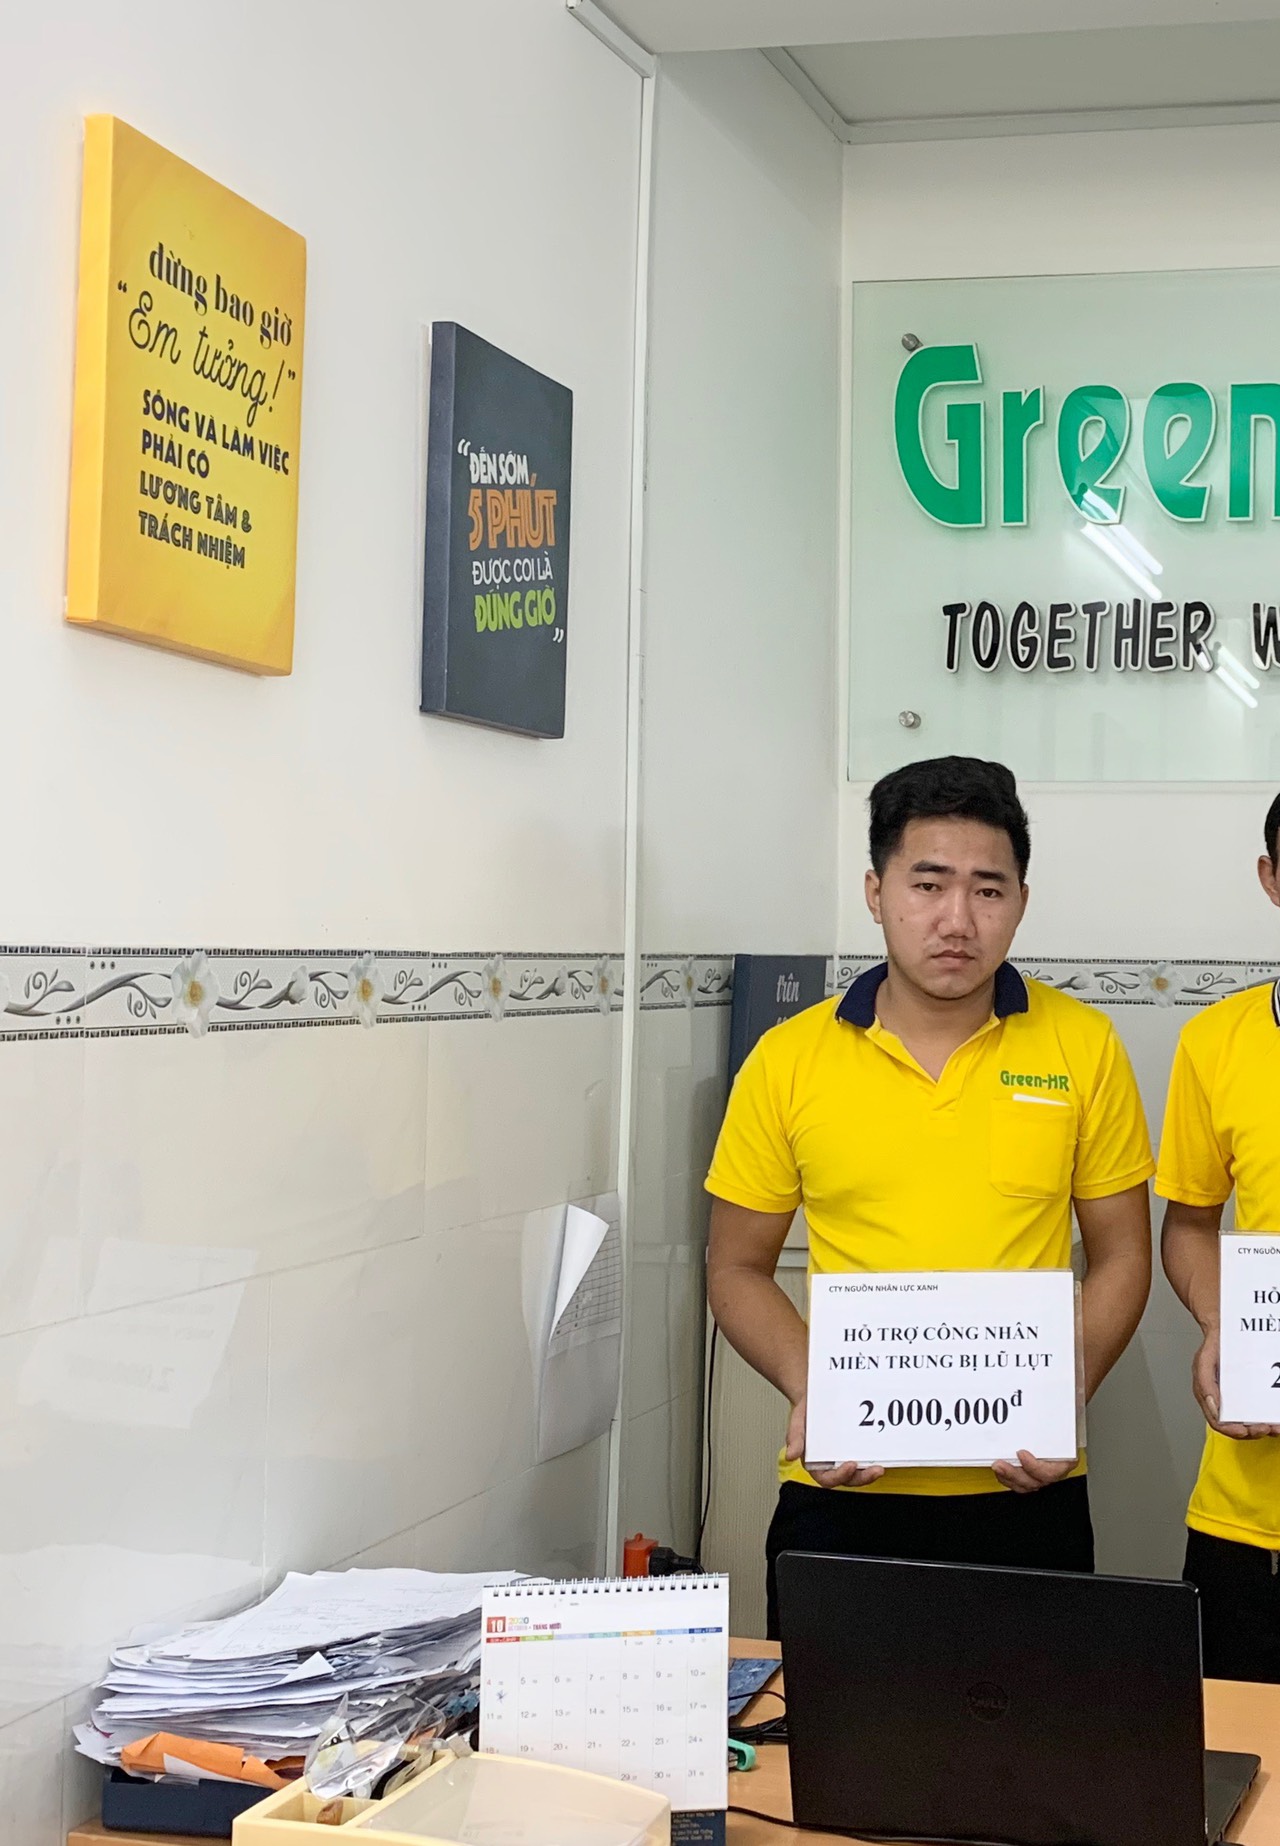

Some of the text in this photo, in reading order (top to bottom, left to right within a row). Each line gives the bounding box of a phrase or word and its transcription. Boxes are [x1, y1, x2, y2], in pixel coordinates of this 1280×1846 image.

[149, 242, 292, 349] đừng bao giờ
[142, 429, 209, 478] PHẢI CÓ
[194, 412, 217, 445] VÀ
[222, 424, 254, 461] LÀM
[259, 440, 289, 475] VIỆC
[499, 450, 529, 485] SỚM
[140, 470, 252, 533] LƯƠNG TÂM &
[468, 473, 557, 551] 5 PHÚT
[139, 510, 245, 569] TRÁCH NHIỆM
[472, 551, 553, 589] ĐƯỢC COI LÀ
[475, 588, 523, 633] ĐÚNG
[942, 599, 1214, 673] TOGETHER
[1000, 1070, 1069, 1092] Green-HR
[829, 1285, 842, 1293] CTY
[876, 1283, 898, 1292] NHÂN
[878, 1326, 918, 1344] TRỢ
[923, 1322, 979, 1341] CÔNG
[985, 1322, 1038, 1340] NHÂN
[886, 1354, 953, 1369] TRUNG
[959, 1354, 977, 1371] BỊ
[984, 1350, 1009, 1368] LŨ
[1015, 1353, 1053, 1371] LỤT
[492, 1620, 503, 1632] 10
[520, 1711, 529, 1719] 12
[656, 1704, 664, 1712] 16
[689, 1702, 698, 1710] 17
[553, 1743, 563, 1751] 20
[688, 1736, 698, 1744] 24
